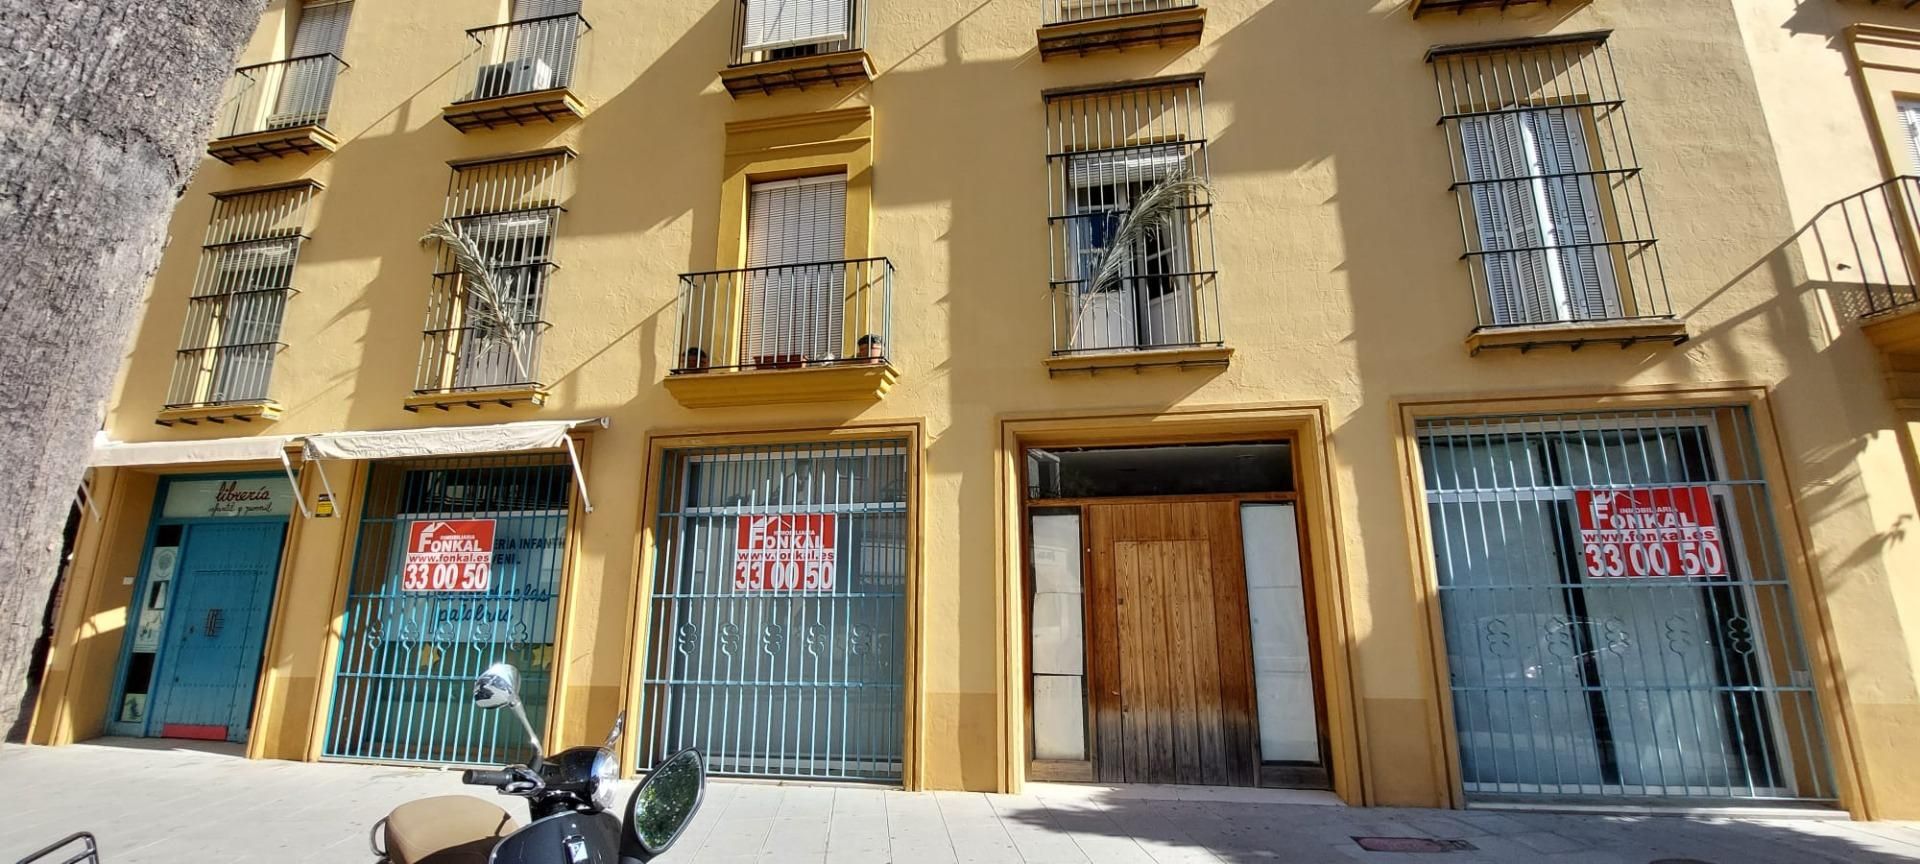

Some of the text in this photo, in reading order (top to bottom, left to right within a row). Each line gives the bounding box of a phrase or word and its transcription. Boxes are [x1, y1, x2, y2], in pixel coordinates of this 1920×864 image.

[1590, 504, 1697, 529] FONKAL
[418, 532, 483, 552] FONKAL
[752, 528, 825, 549] FONKAL
[1583, 530, 1716, 542] www.fonkal.es
[409, 553, 489, 563] www.fonkal.es
[1585, 540, 1722, 577] 33 00 50
[405, 562, 488, 589] 33 00 50
[735, 561, 833, 589] 33 00 50
